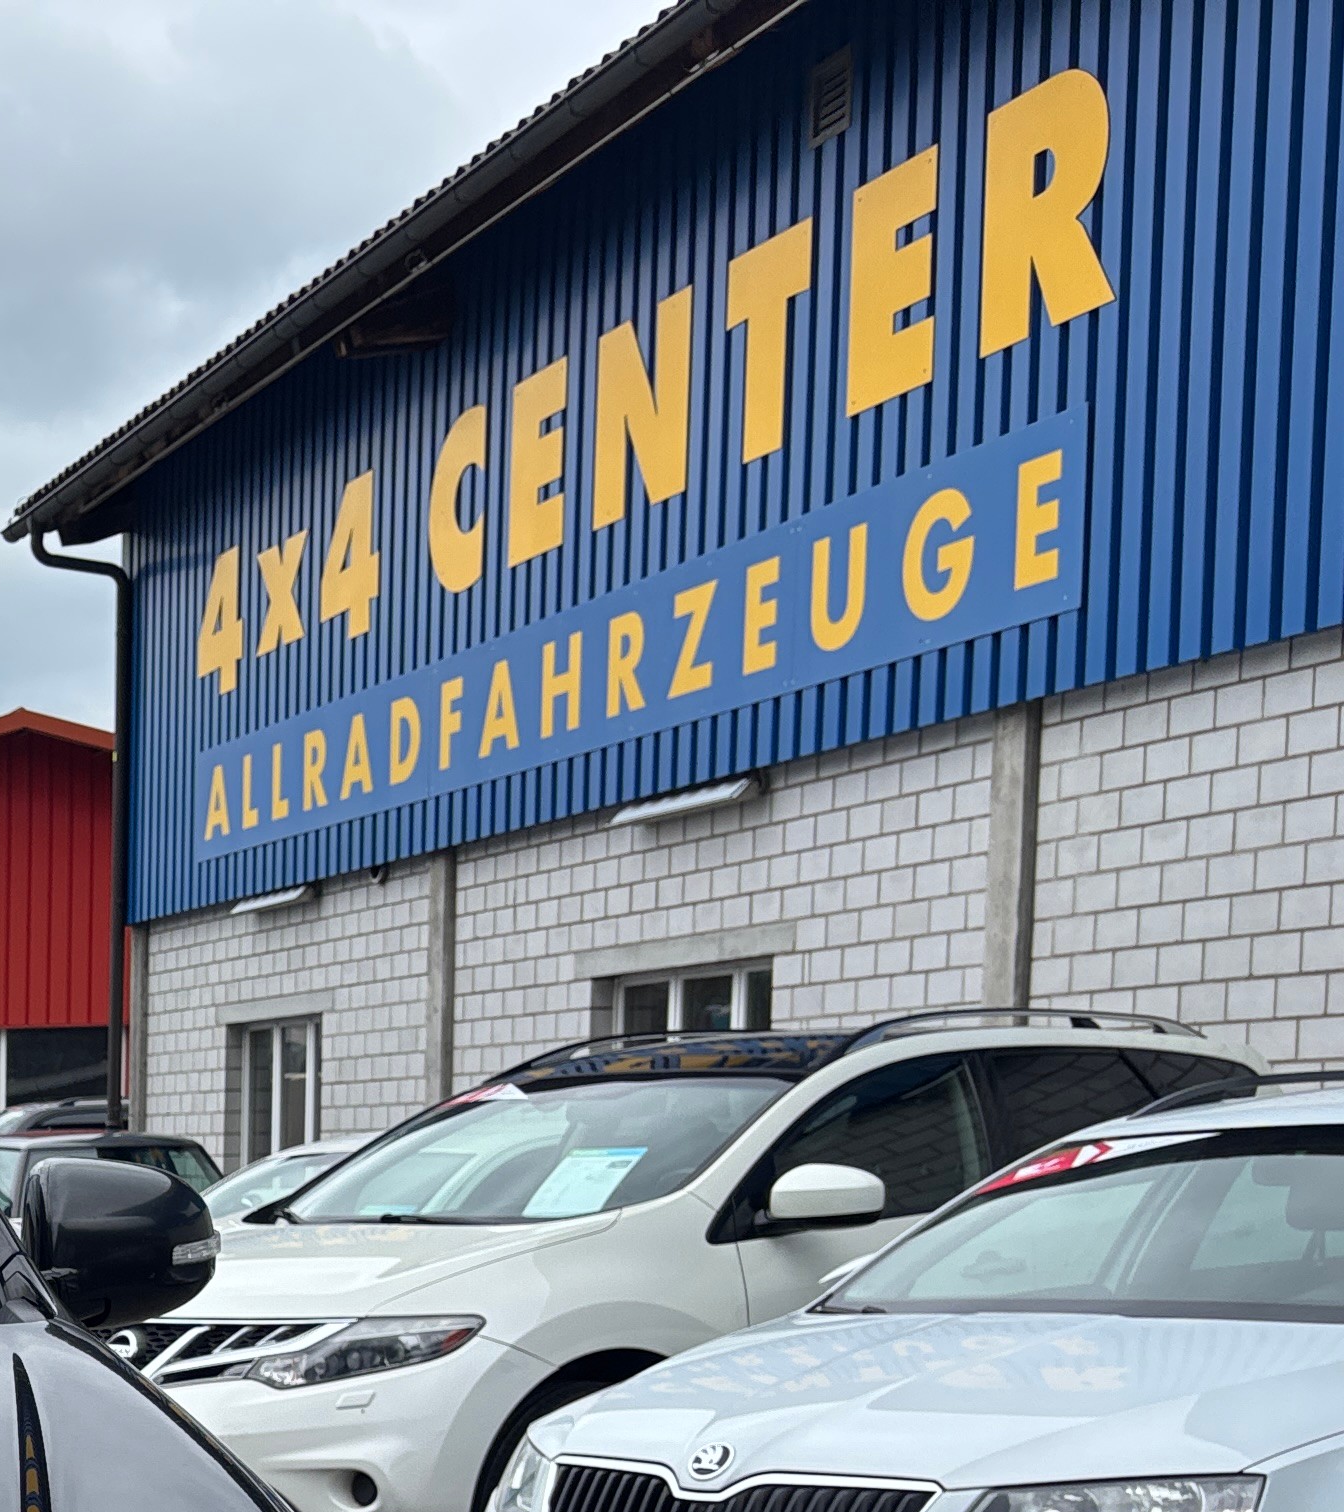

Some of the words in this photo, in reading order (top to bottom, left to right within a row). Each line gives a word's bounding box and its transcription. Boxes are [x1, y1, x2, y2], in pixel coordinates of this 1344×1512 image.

[196, 468, 380, 694] 4x4
[427, 67, 1117, 594] CENTER
[203, 447, 1064, 842] ALLRADFAHRZEUGE
